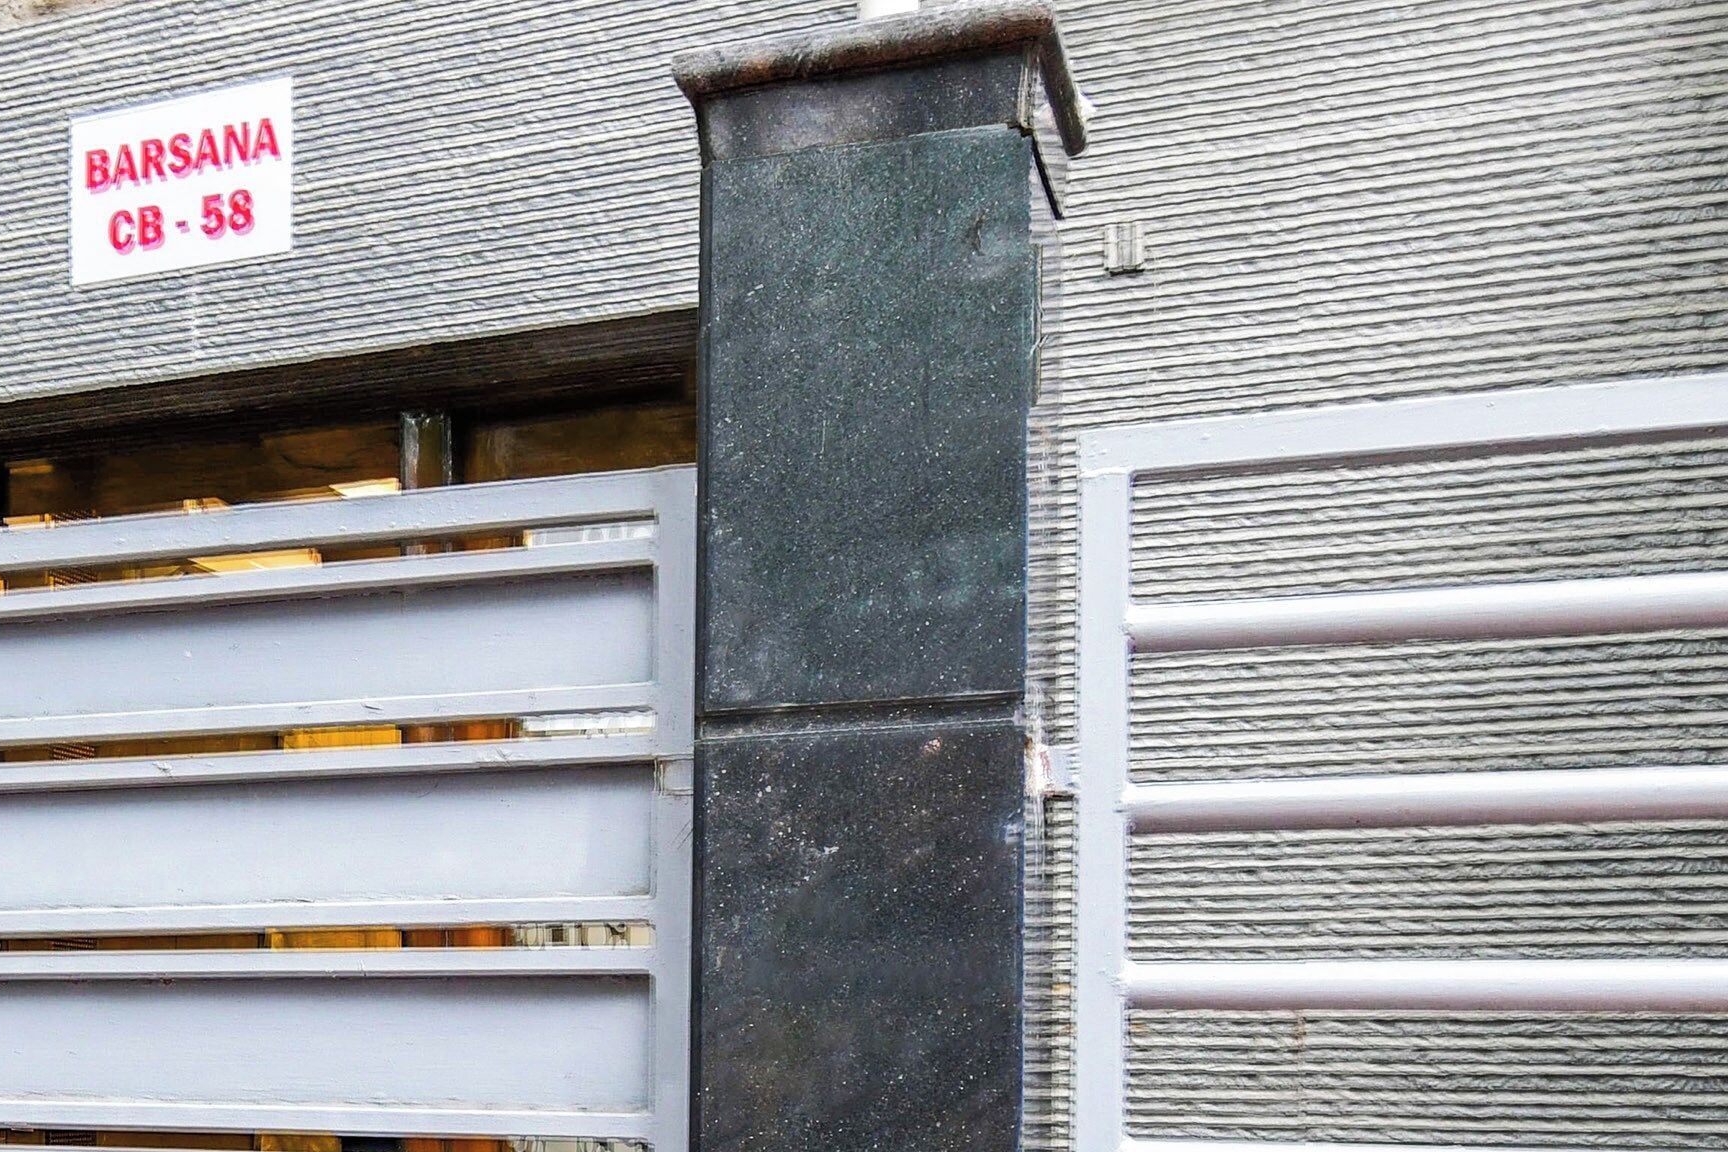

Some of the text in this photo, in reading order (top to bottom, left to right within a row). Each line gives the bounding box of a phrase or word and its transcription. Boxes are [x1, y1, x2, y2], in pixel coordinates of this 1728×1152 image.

[84, 117, 282, 193] BARSANA
[108, 205, 165, 255] CB
[200, 189, 255, 240] 58
